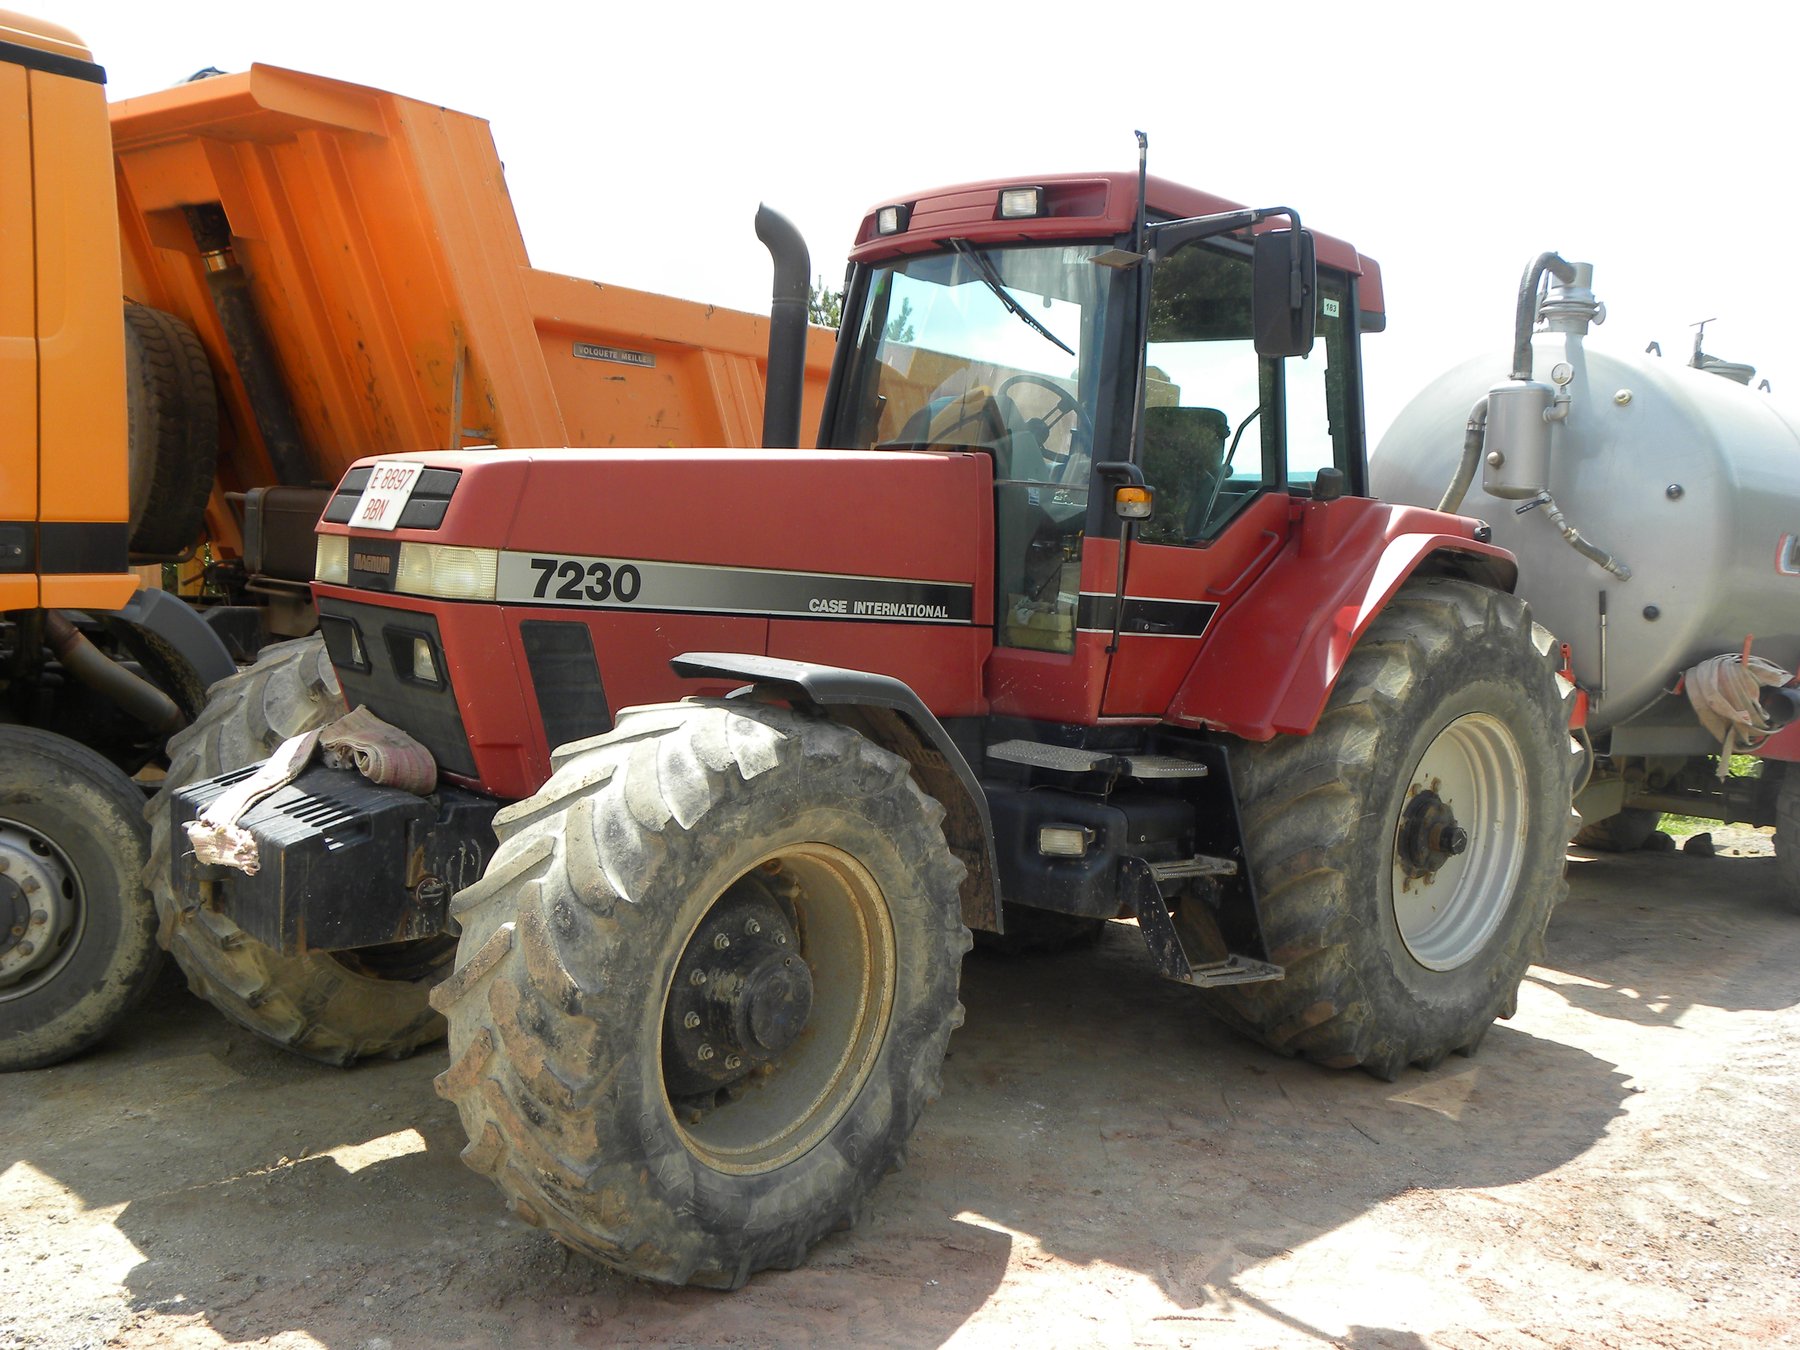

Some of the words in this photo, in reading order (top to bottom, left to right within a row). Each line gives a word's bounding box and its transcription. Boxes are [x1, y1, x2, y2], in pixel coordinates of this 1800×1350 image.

[1326, 303, 1336, 312] 183
[578, 345, 618, 359] VOLQUETE
[371, 468, 384, 489] E
[381, 468, 415, 490] 8897
[362, 498, 390, 521] BBN
[530, 559, 642, 603] 7230
[808, 598, 848, 615] CASE
[853, 601, 949, 618] INTERNATIONAL
